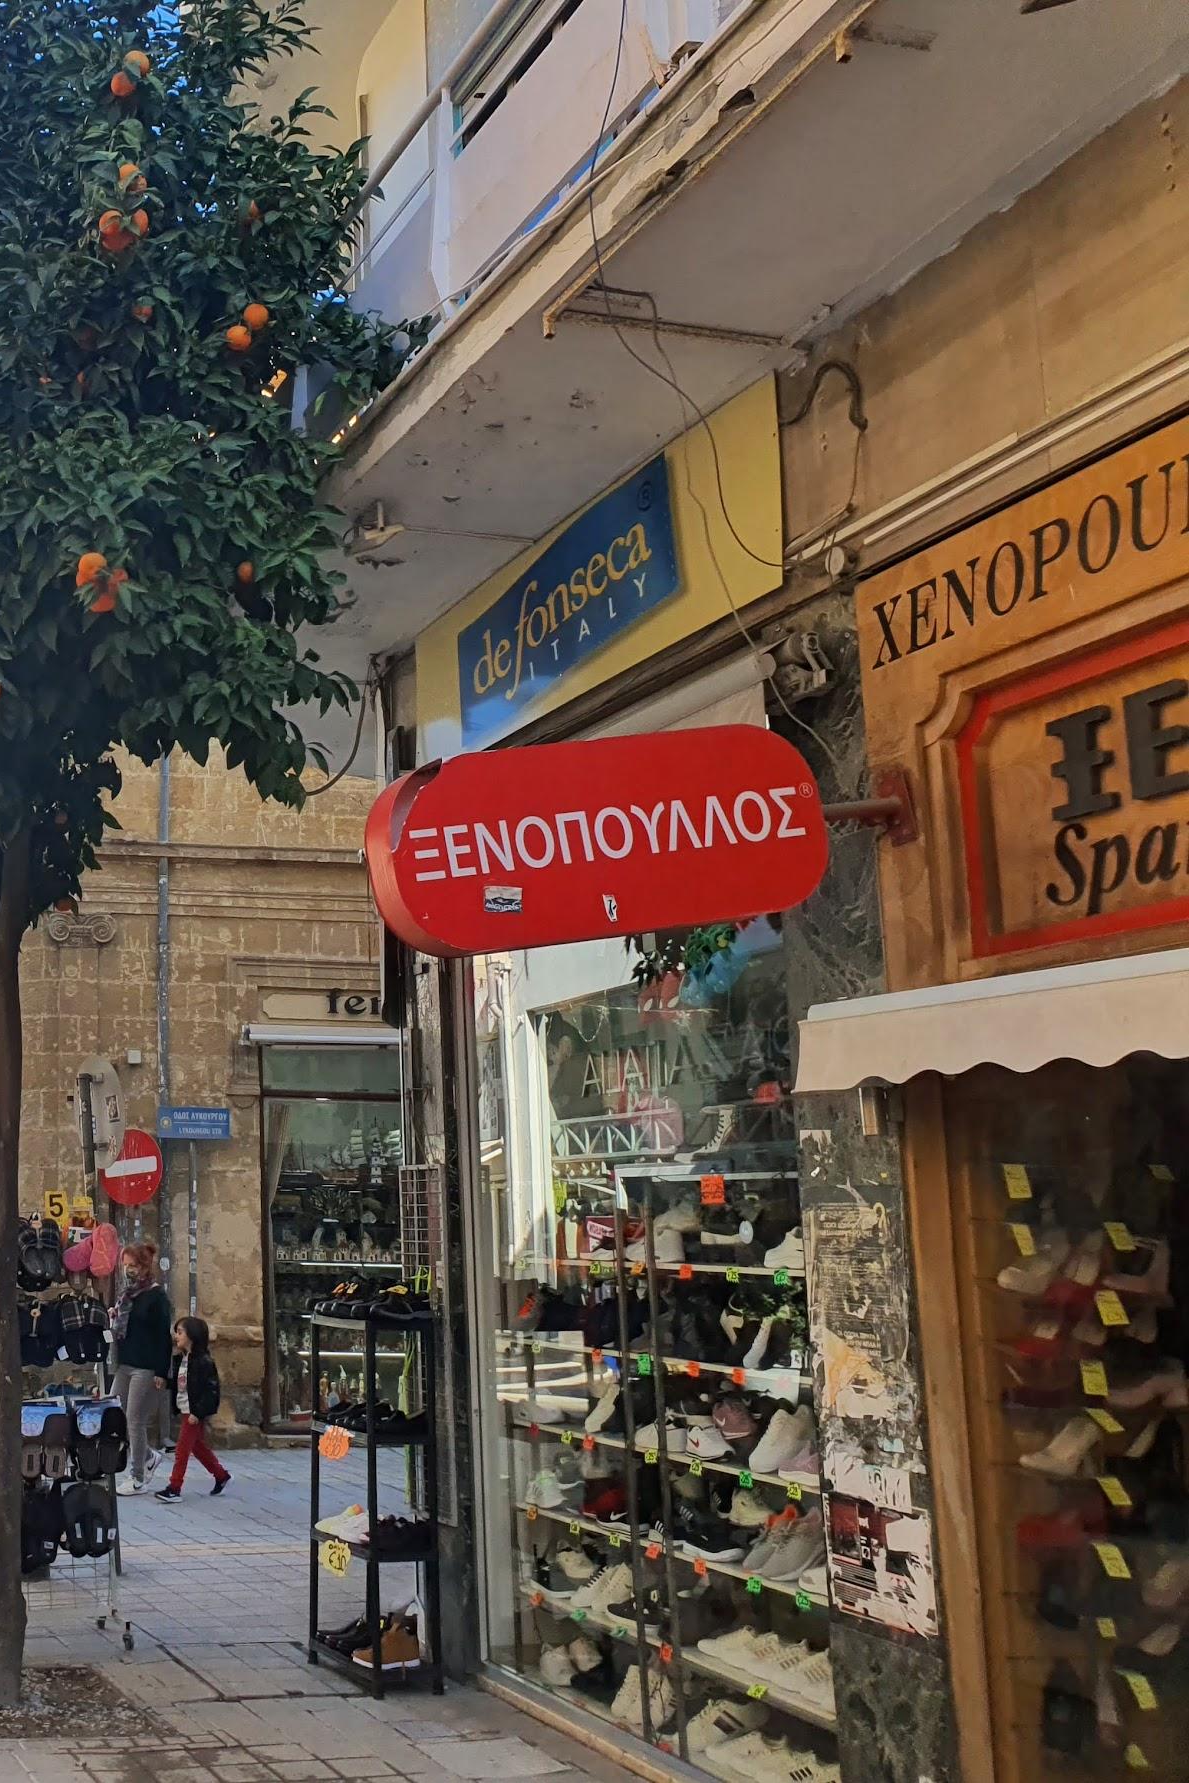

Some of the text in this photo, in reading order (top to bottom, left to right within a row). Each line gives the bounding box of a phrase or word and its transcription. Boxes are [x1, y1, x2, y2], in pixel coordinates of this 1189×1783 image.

[871, 453, 1189, 670] XENOPOU
[527, 572, 647, 681] ITALY
[409, 786, 807, 882] ΞΕΝΟΠΟΥΛΛΟΣ
[1046, 822, 1189, 916] Spa
[173, 1111, 227, 1121] ΟΔΟΣ ΛΥΚΟΥΡΓΟΥ
[49, 1194, 63, 1218] 5
